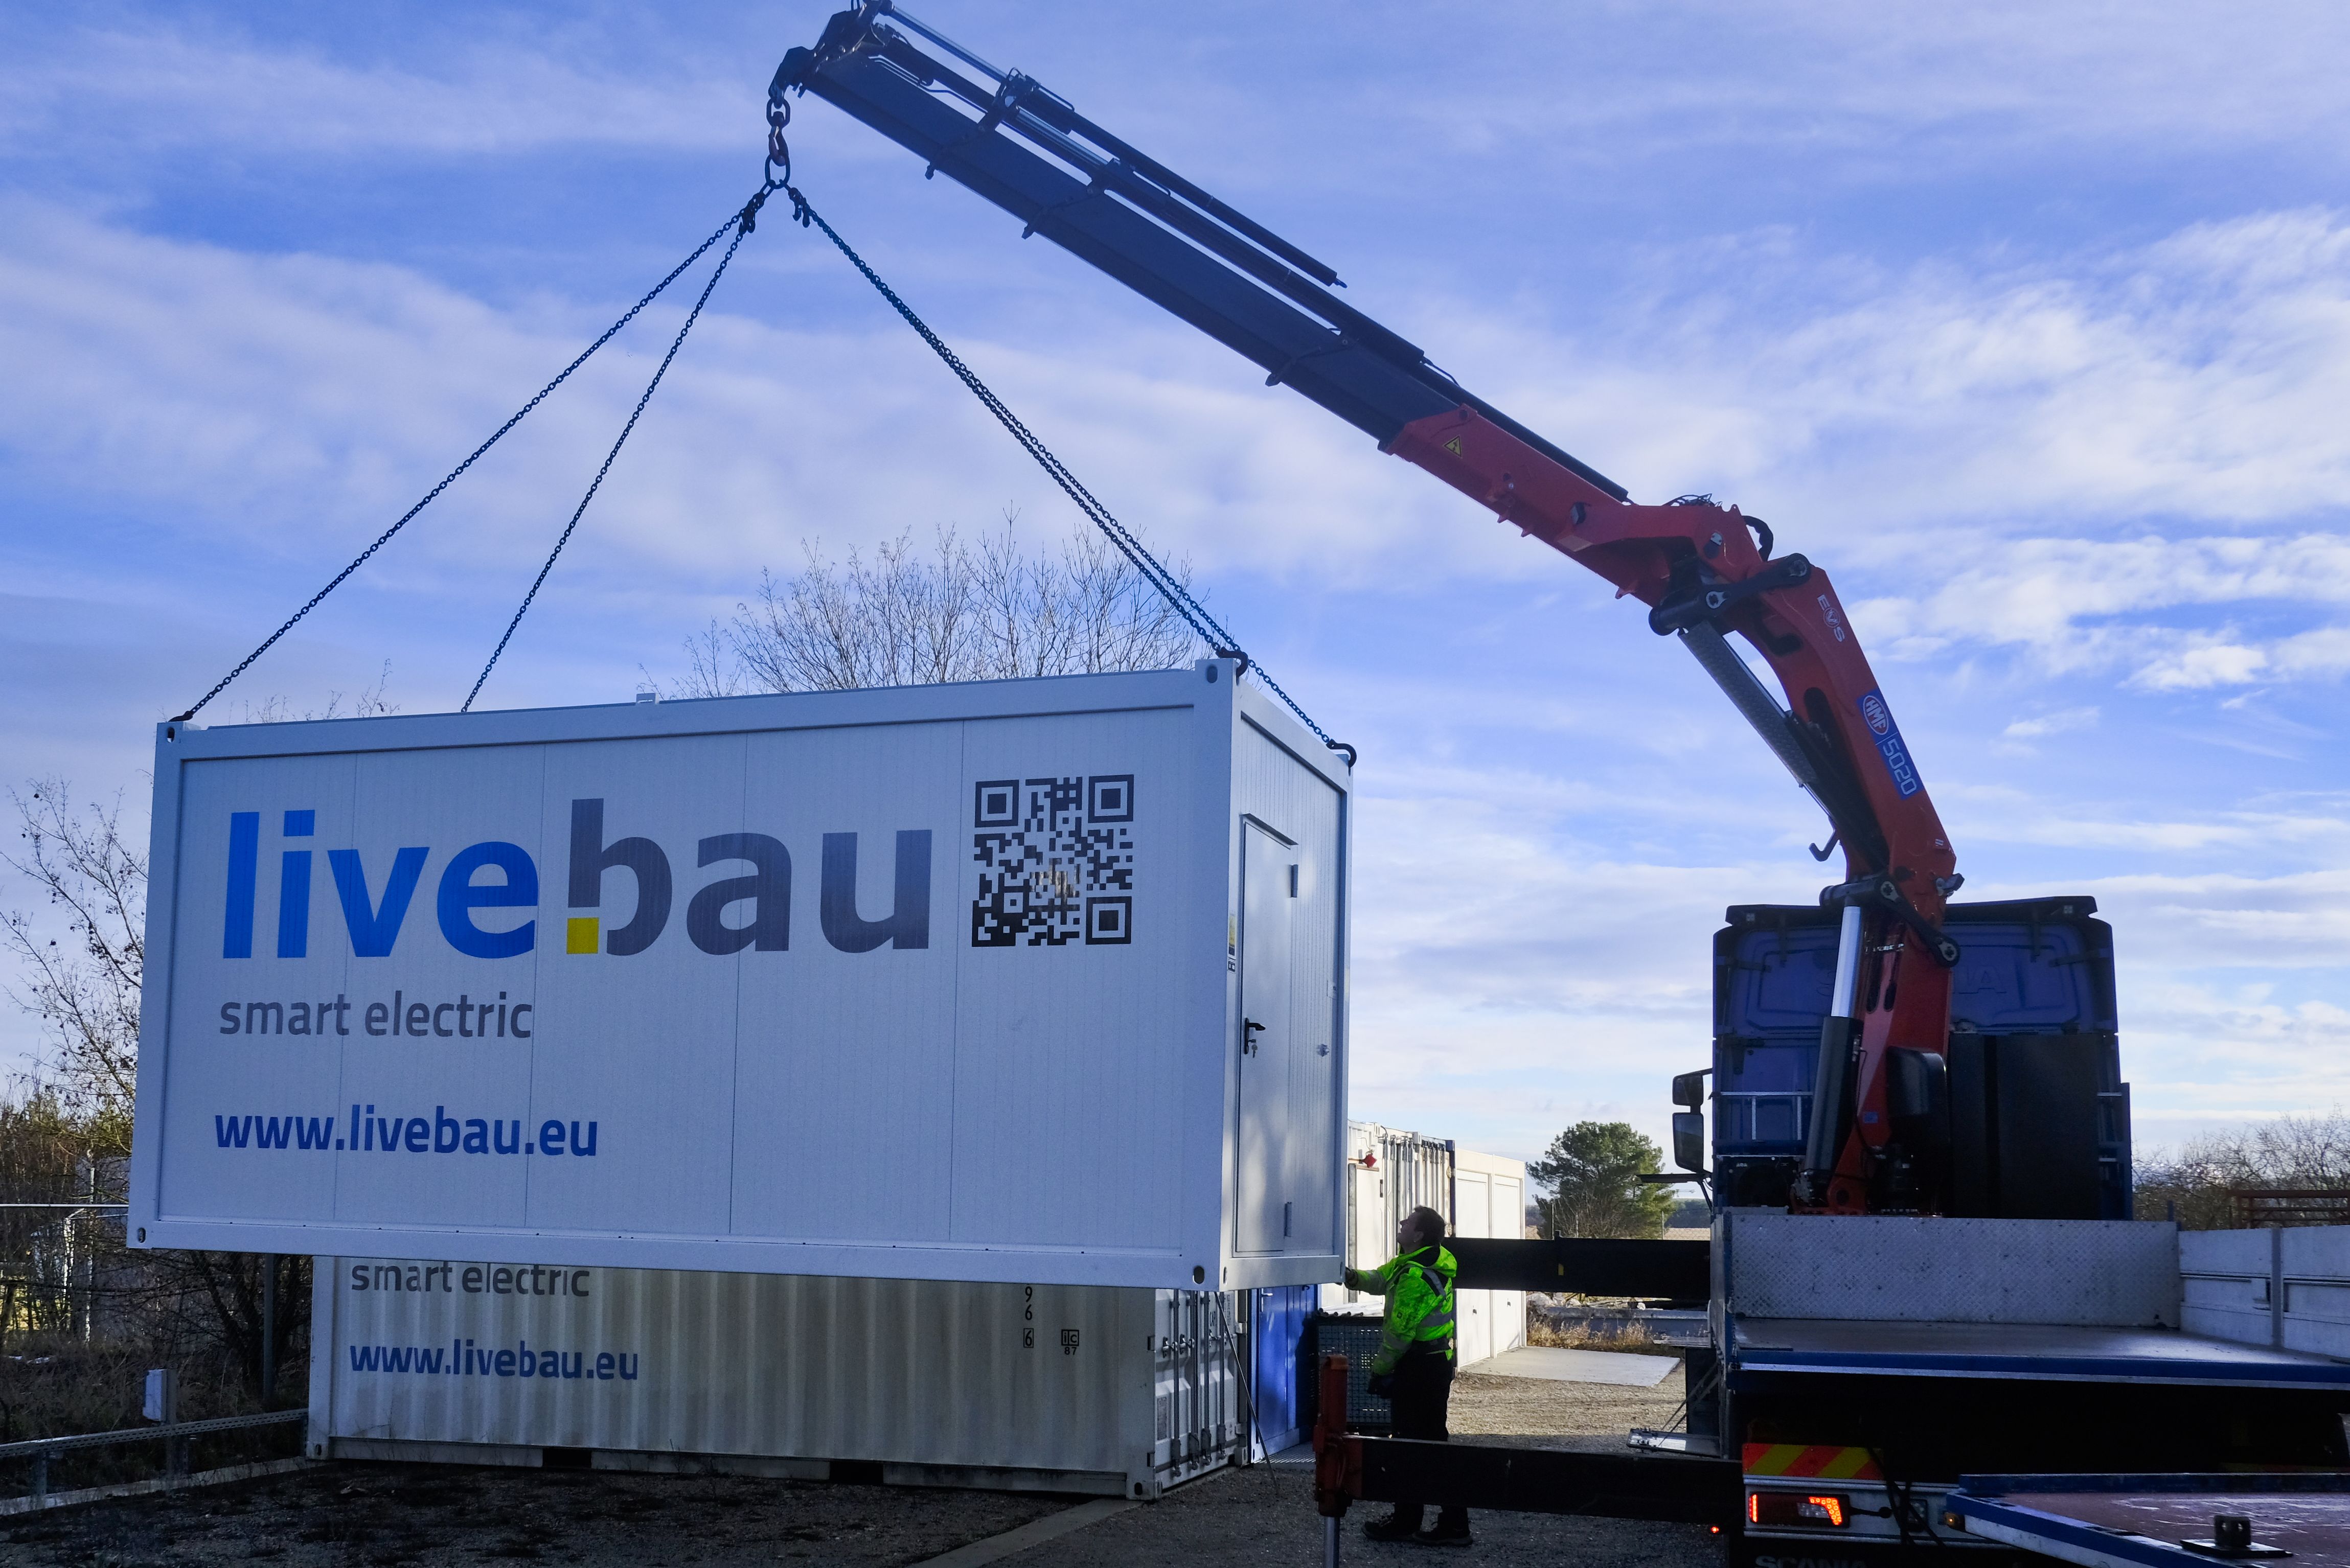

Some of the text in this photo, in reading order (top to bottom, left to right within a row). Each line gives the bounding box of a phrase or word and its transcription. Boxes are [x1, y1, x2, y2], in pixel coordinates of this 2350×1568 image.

[1864, 699, 1917, 795] HMF 5020
[219, 990, 533, 1039] smart electric
[214, 1104, 598, 1157] www.livebau.eu
[351, 1261, 590, 1297] smart electric
[350, 1339, 638, 1380] www.livebau.eu
[1064, 1346, 1077, 1355] 87
